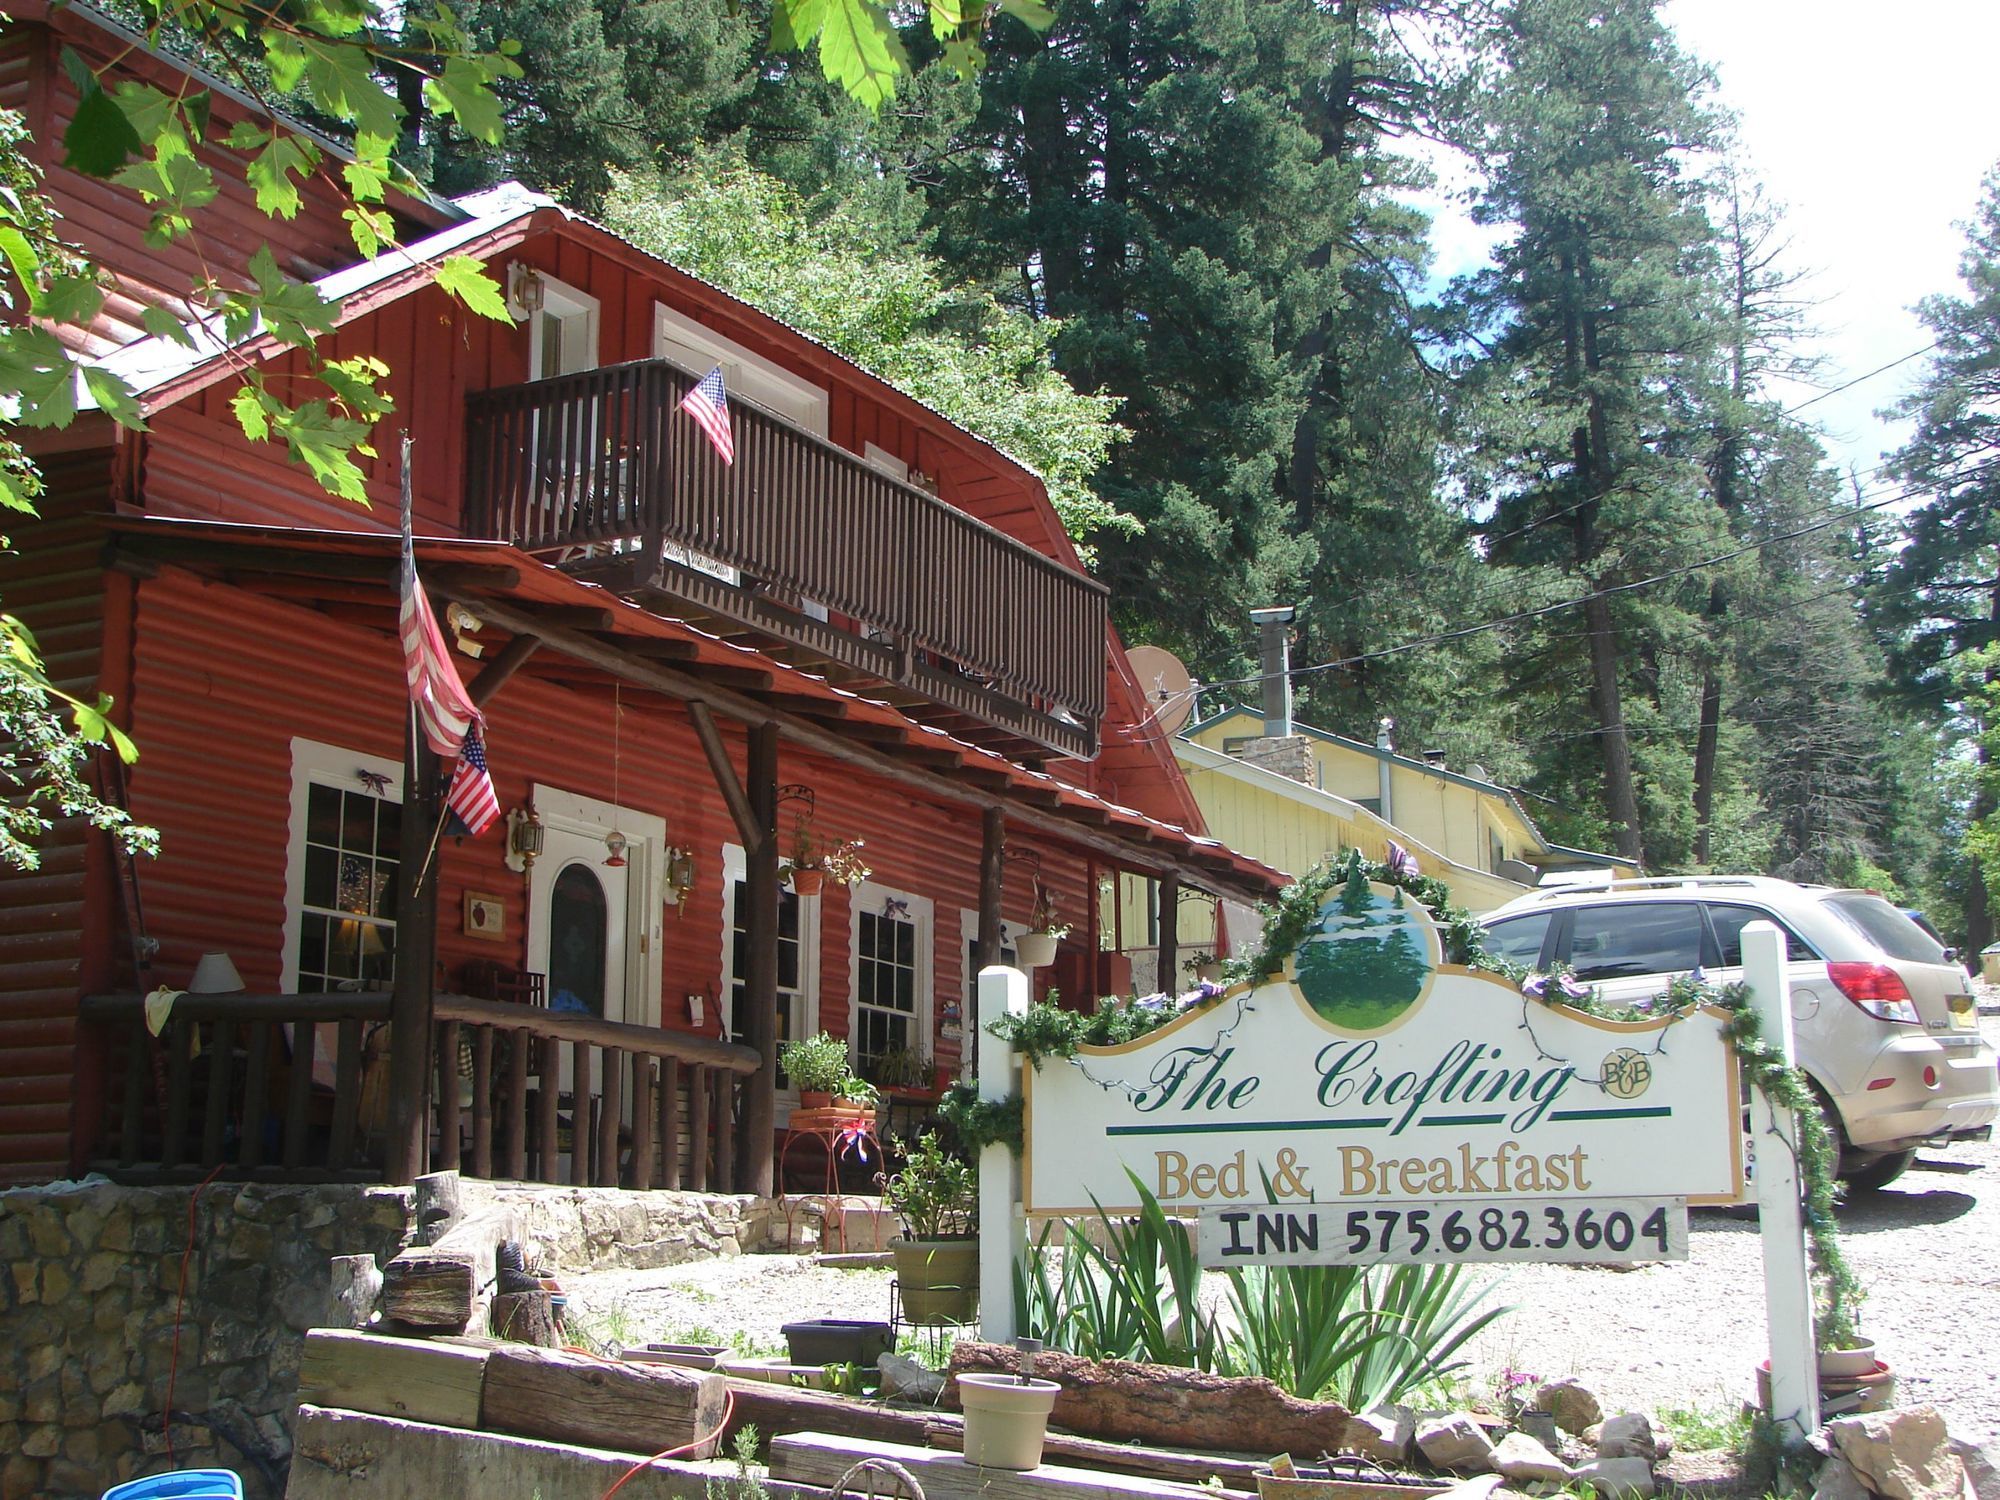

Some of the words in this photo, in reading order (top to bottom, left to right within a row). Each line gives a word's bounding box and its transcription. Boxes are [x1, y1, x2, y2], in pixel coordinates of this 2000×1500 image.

[1134, 1046, 1260, 1113] The
[1314, 1039, 1576, 1137] Crofting
[1154, 1149, 1250, 1200] Bed
[1271, 1147, 1313, 1198] &
[1336, 1140, 1593, 1196] Breakfast
[1219, 1210, 1319, 1256] INN
[1346, 1206, 1669, 1256] 575.682.3604
